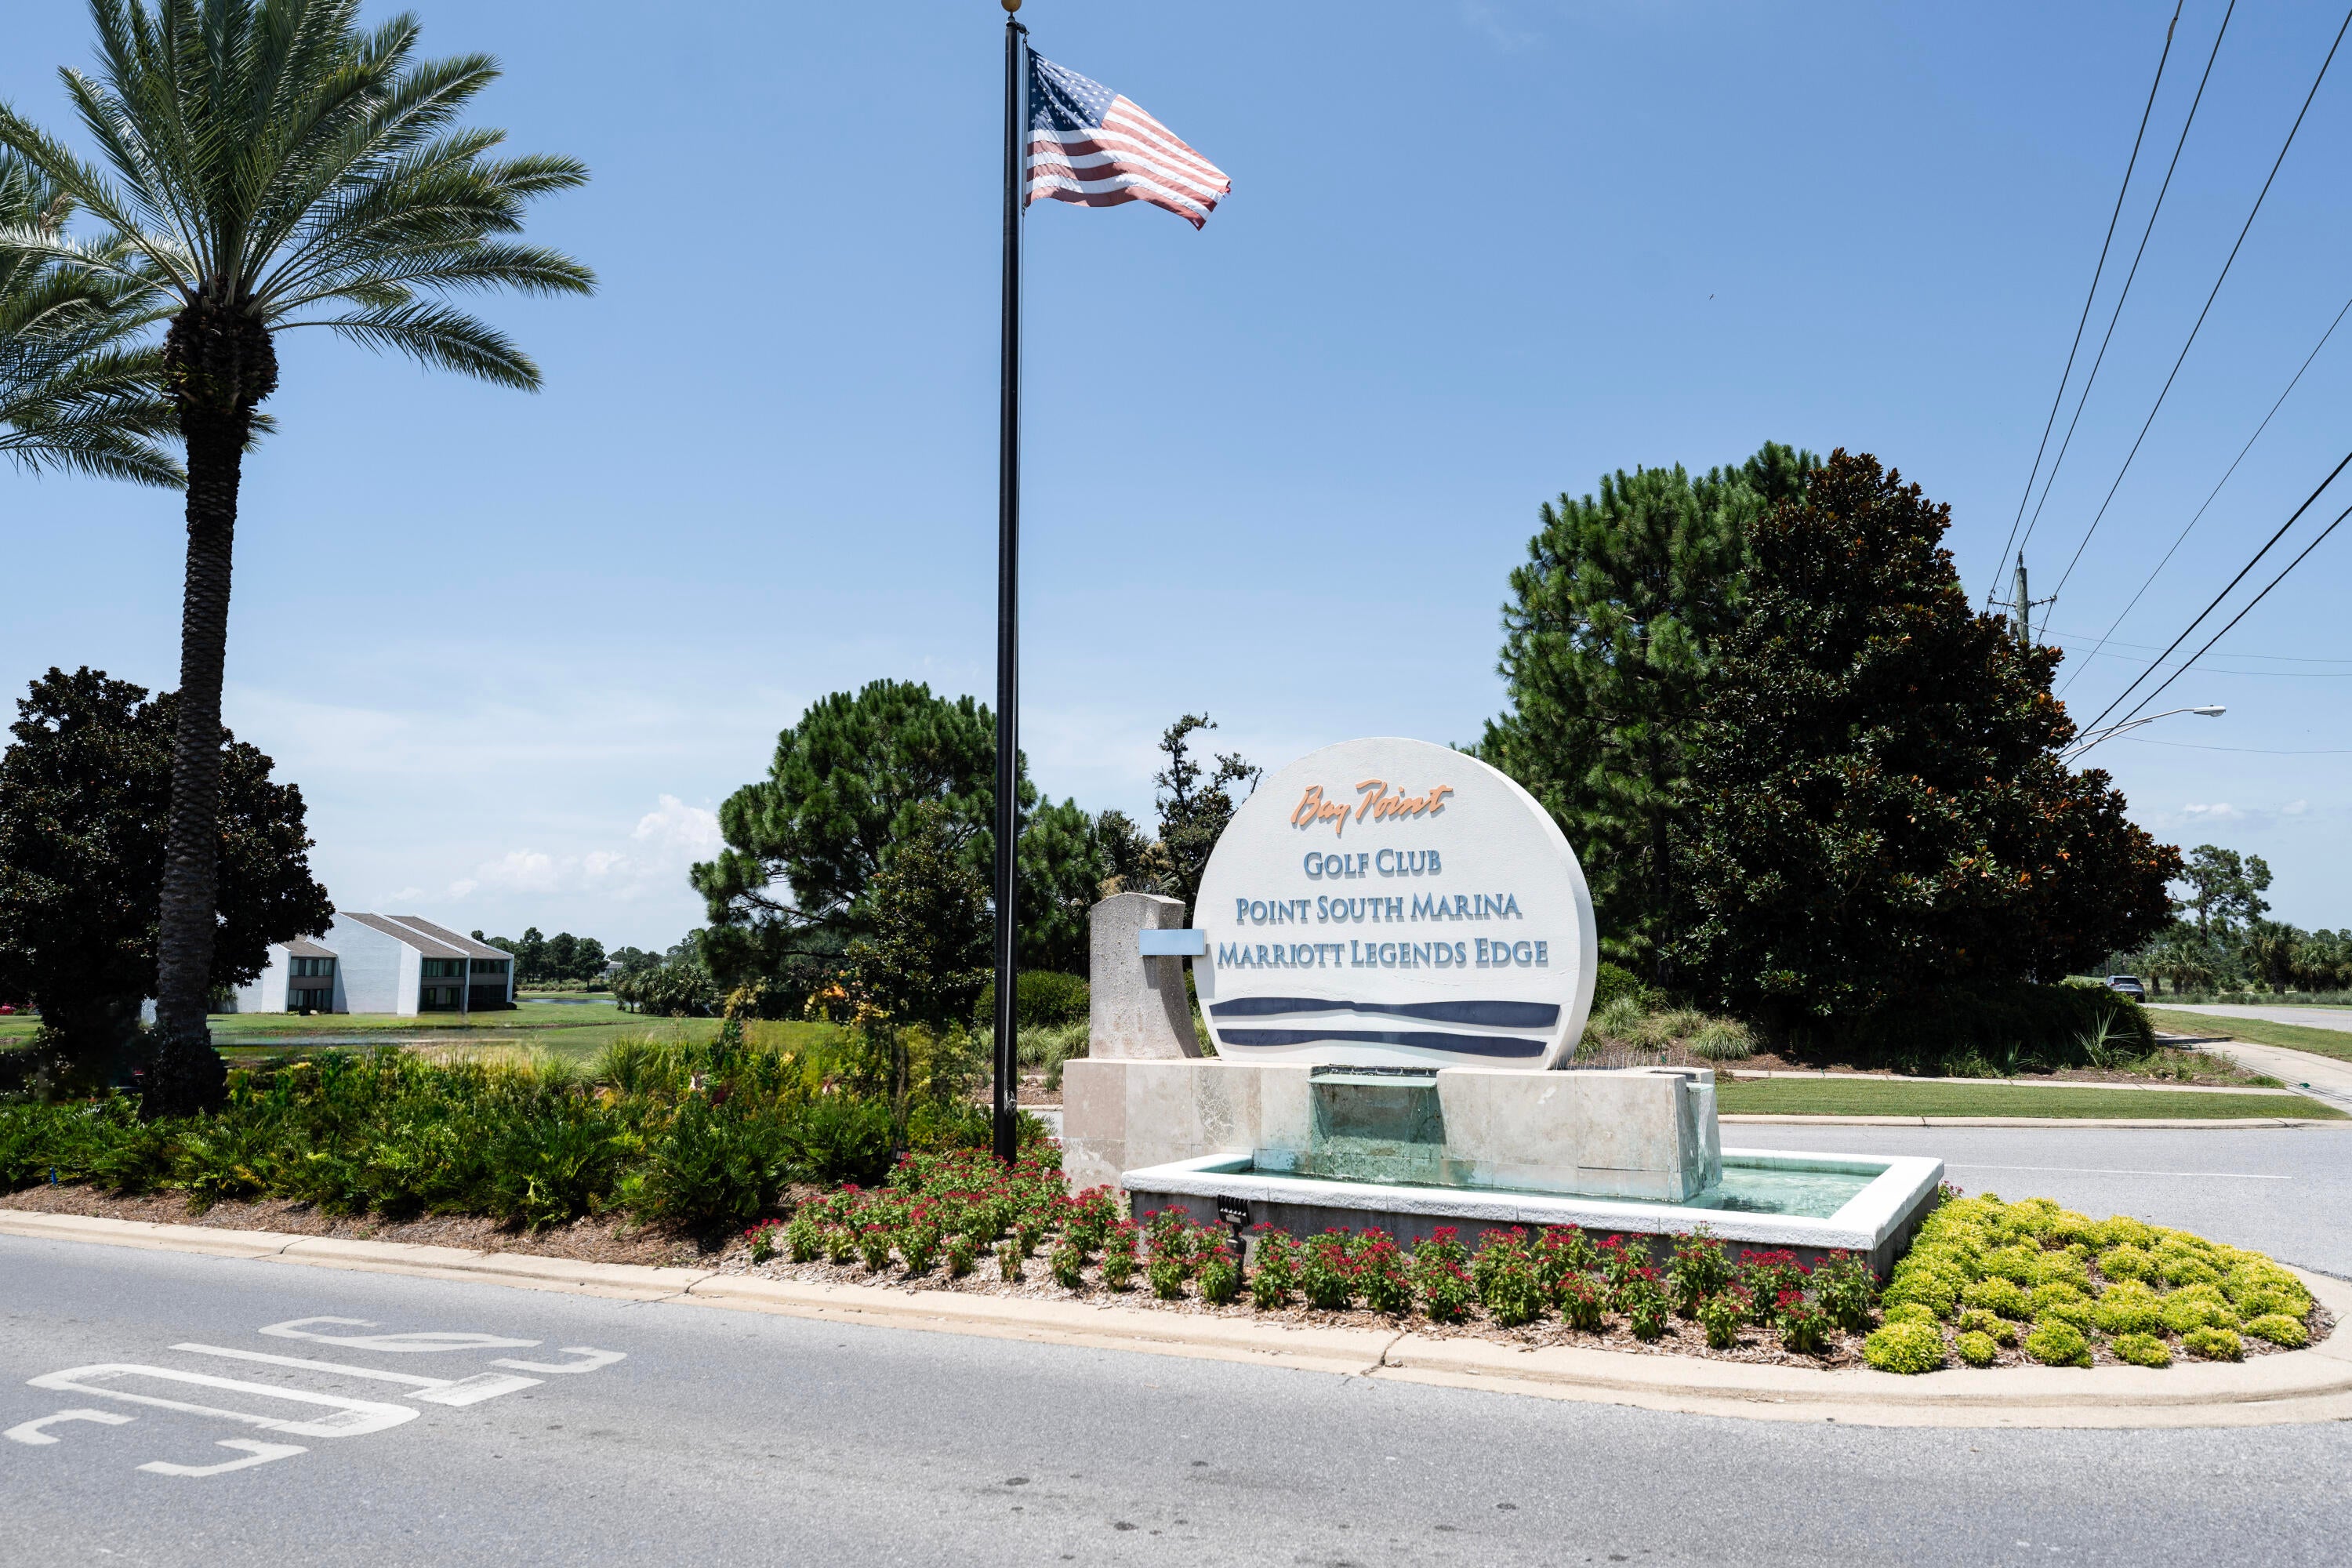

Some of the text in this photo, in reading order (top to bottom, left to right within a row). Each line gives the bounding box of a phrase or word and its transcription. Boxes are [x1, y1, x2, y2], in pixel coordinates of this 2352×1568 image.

[1290, 779, 1454, 835] Bay Point
[1303, 848, 1442, 876] GOLF CLUB
[1236, 891, 1523, 921] POINT SOUTH MARINA
[1217, 937, 1548, 965] MARRIOTT LEGENDS EDGE
